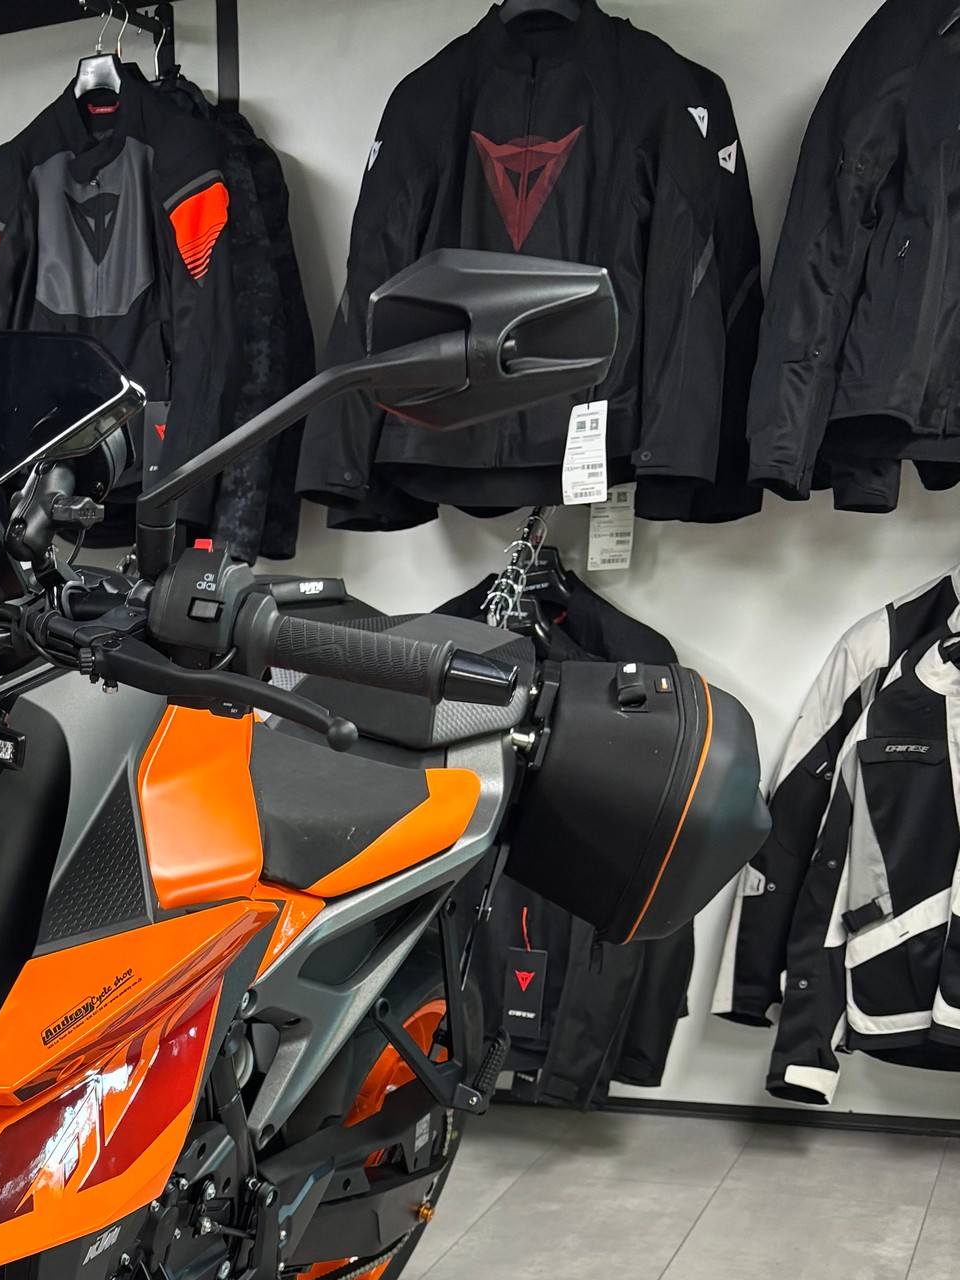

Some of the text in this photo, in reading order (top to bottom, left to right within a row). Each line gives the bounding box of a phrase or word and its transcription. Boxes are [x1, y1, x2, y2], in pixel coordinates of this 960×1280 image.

[44, 1001, 94, 1040] Andrey
[113, 967, 133, 987] shop
[82, 1225, 122, 1266] KTM
